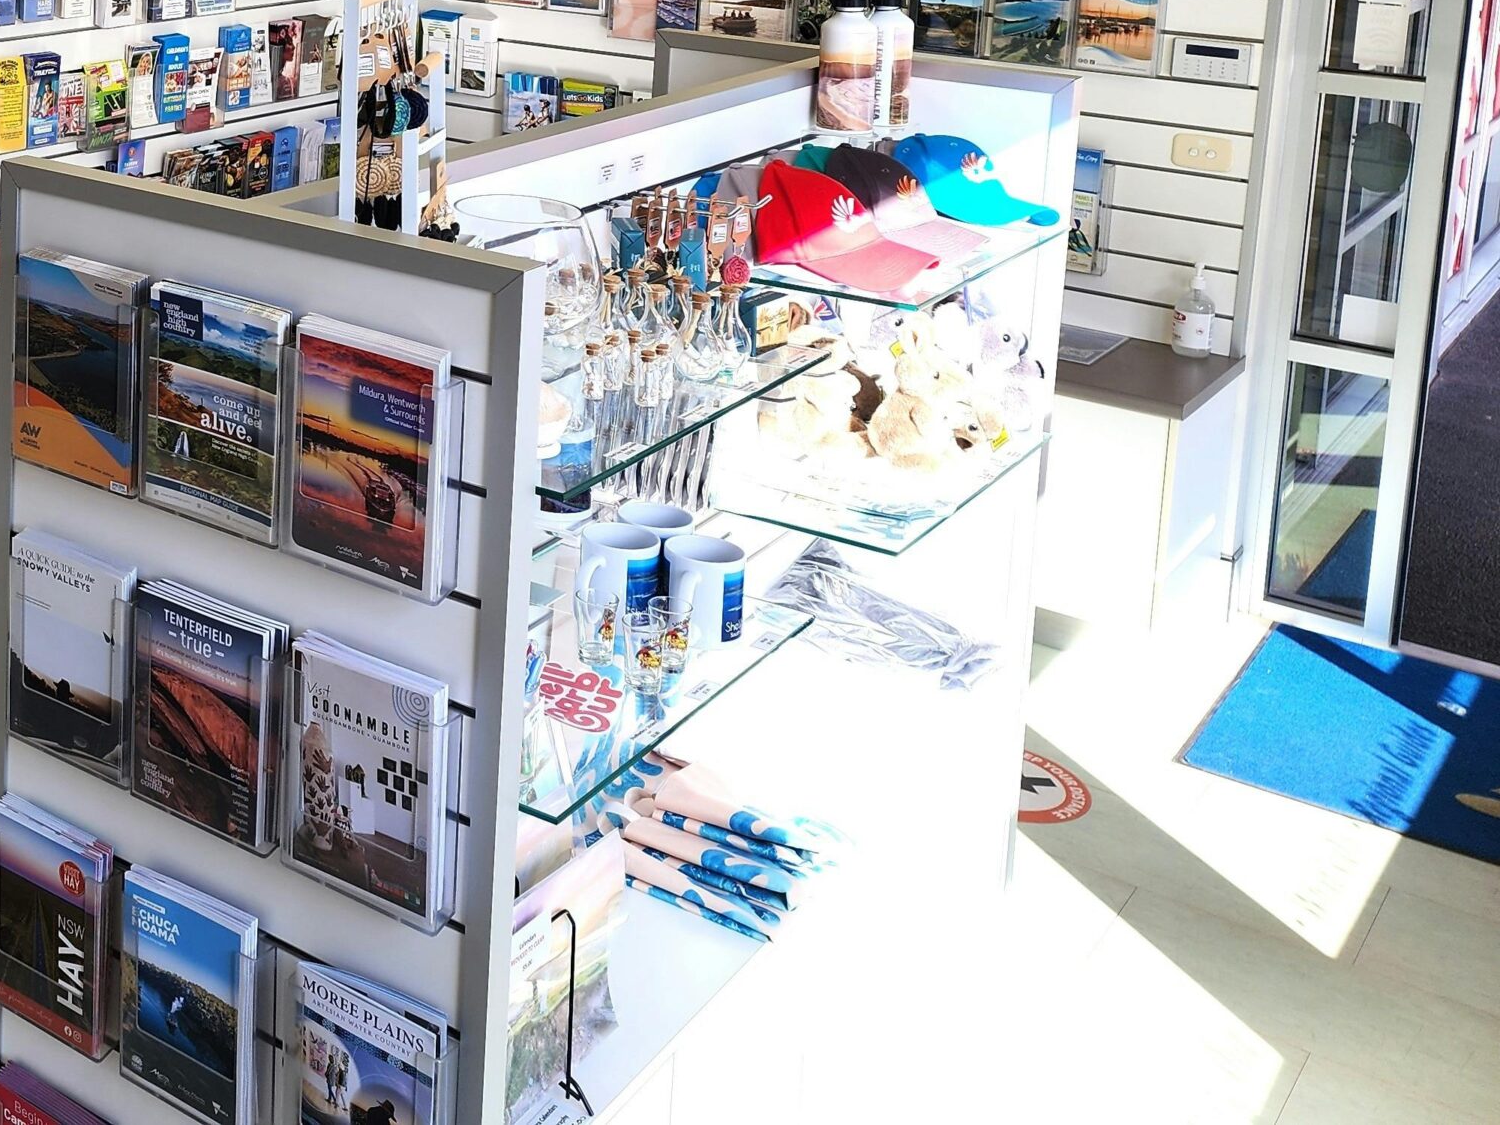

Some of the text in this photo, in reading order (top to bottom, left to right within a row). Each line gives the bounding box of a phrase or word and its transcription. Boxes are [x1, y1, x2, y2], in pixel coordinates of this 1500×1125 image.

[163, 301, 180, 311] new
[166, 309, 200, 323] england
[163, 322, 196, 337] country
[167, 314, 187, 327] high
[213, 395, 261, 419] come up
[219, 407, 263, 430] and feel
[19, 421, 42, 438] AW
[180, 484, 240, 513] REGIONAL MAP GUIDE
[17, 547, 25, 558] A
[25, 549, 50, 566] QUICK
[50, 560, 75, 575] GUIDE
[84, 571, 96, 584] the
[17, 556, 92, 593] SNOWY VALLEYS
[163, 607, 234, 648] TENTERFIELD
[179, 629, 213, 659] true
[306, 680, 332, 698] Visit
[311, 694, 411, 745] COONAMBLE
[372, 733, 411, 753] QUAMBONE
[140, 758, 158, 771] new
[143, 765, 175, 786] england
[1043, 757, 1075, 784] YOUR
[140, 778, 172, 799] country
[144, 772, 164, 785] high
[1053, 782, 1088, 821] DISTANCE
[63, 873, 82, 892] HAY
[57, 913, 85, 941] NSW
[56, 930, 86, 1016] HAY
[303, 974, 424, 1054] MOREE PLAINS
[312, 999, 412, 1058] ARTESIAN WATER COUNTRY
